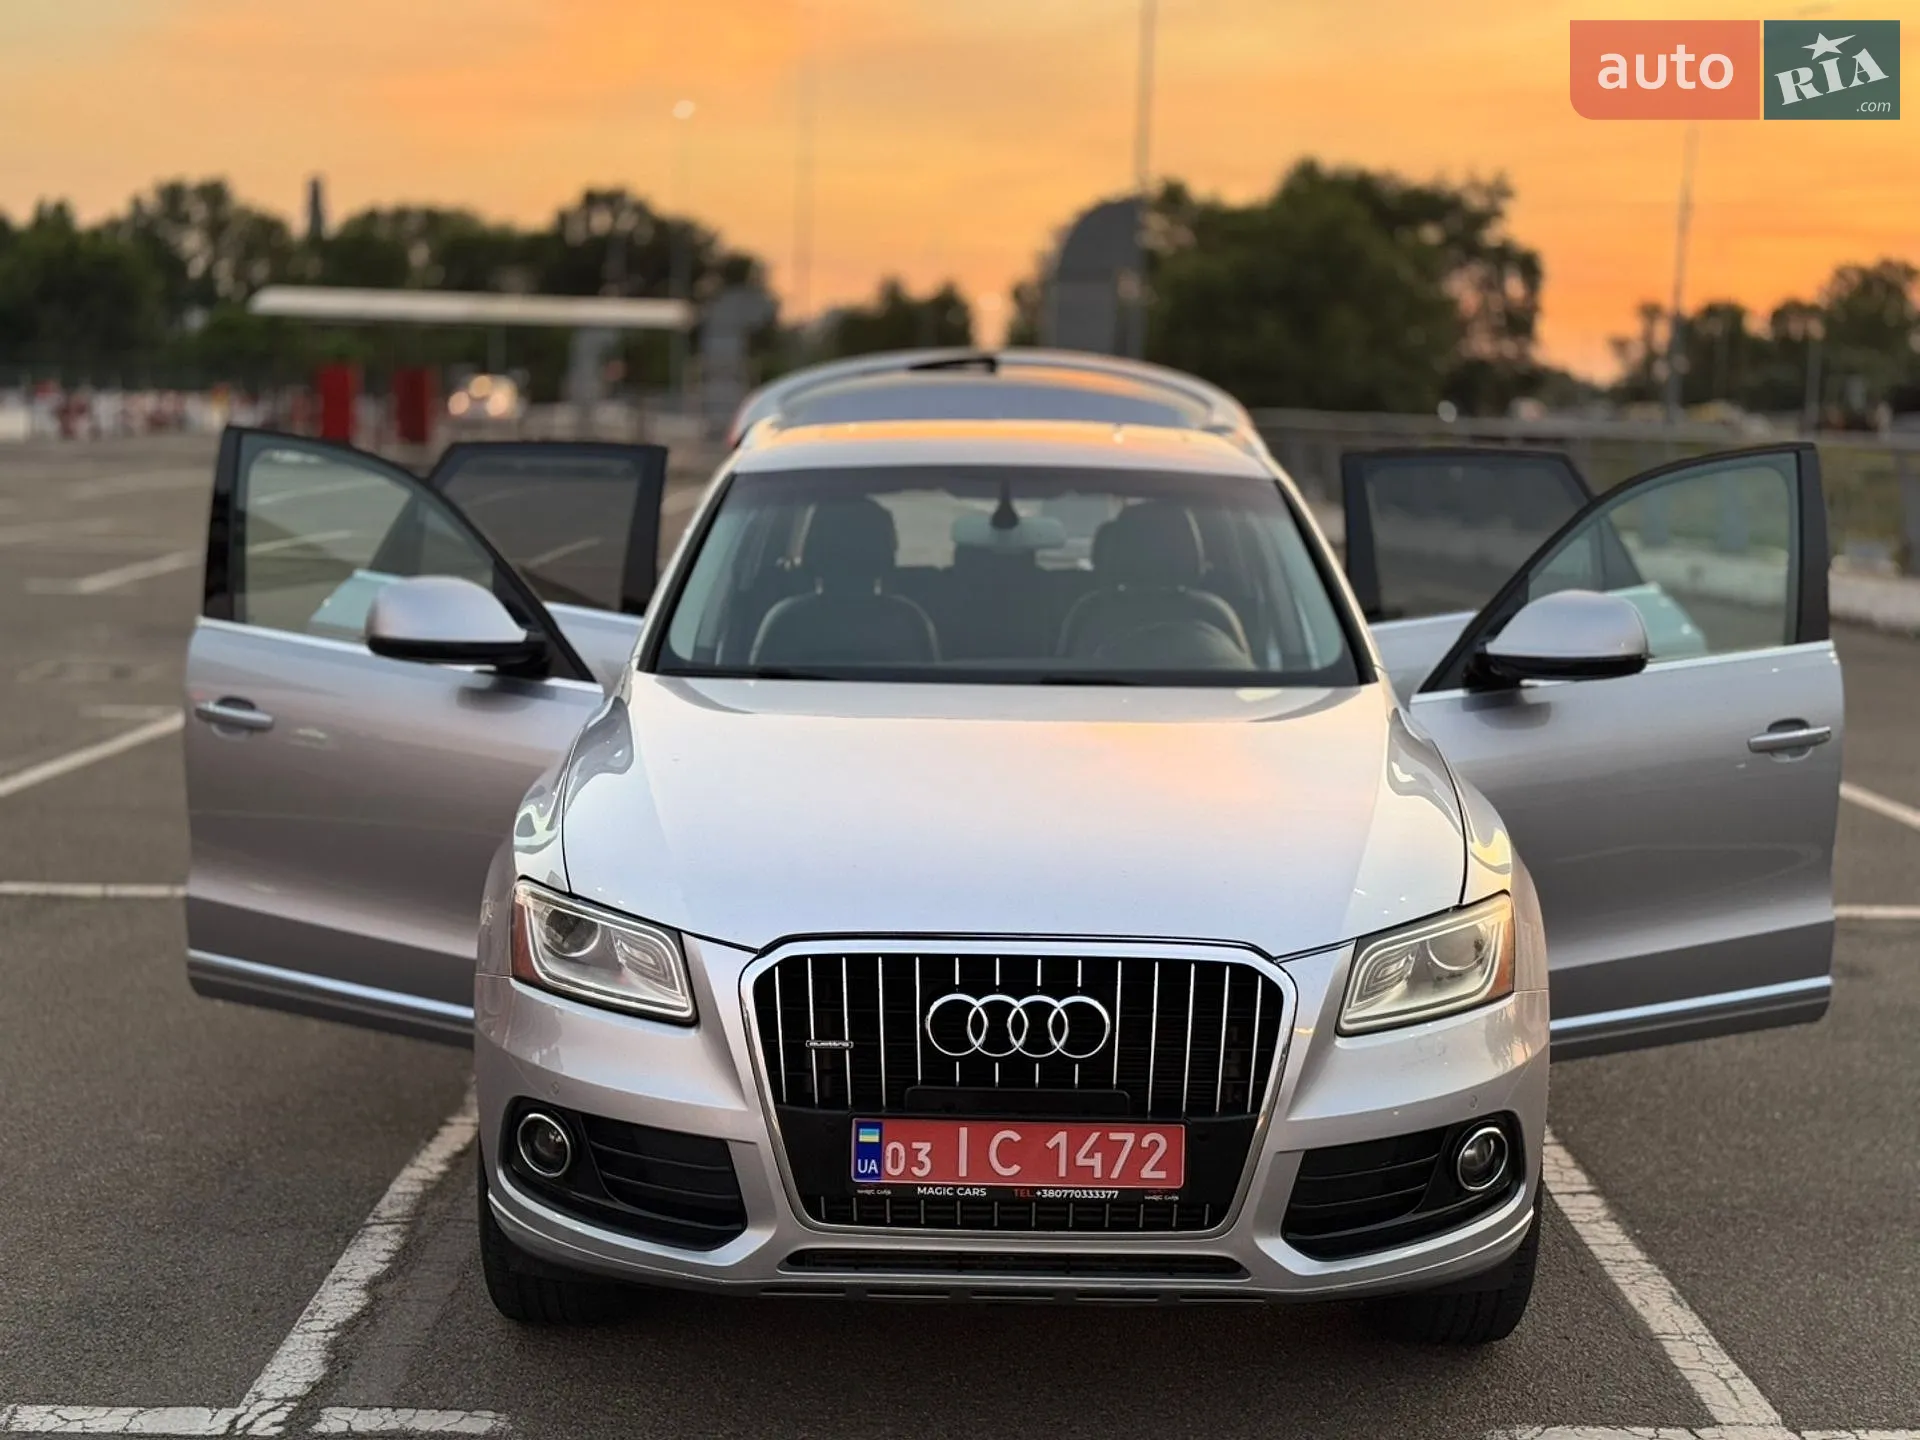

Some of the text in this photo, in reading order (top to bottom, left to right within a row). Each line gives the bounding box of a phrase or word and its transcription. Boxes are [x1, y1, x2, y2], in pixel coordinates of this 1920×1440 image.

[884, 1141, 933, 1177] 03
[1045, 1131, 1168, 1179] 1472
[857, 1158, 879, 1175] UA
[917, 1186, 987, 1197] MAGIC CARS
